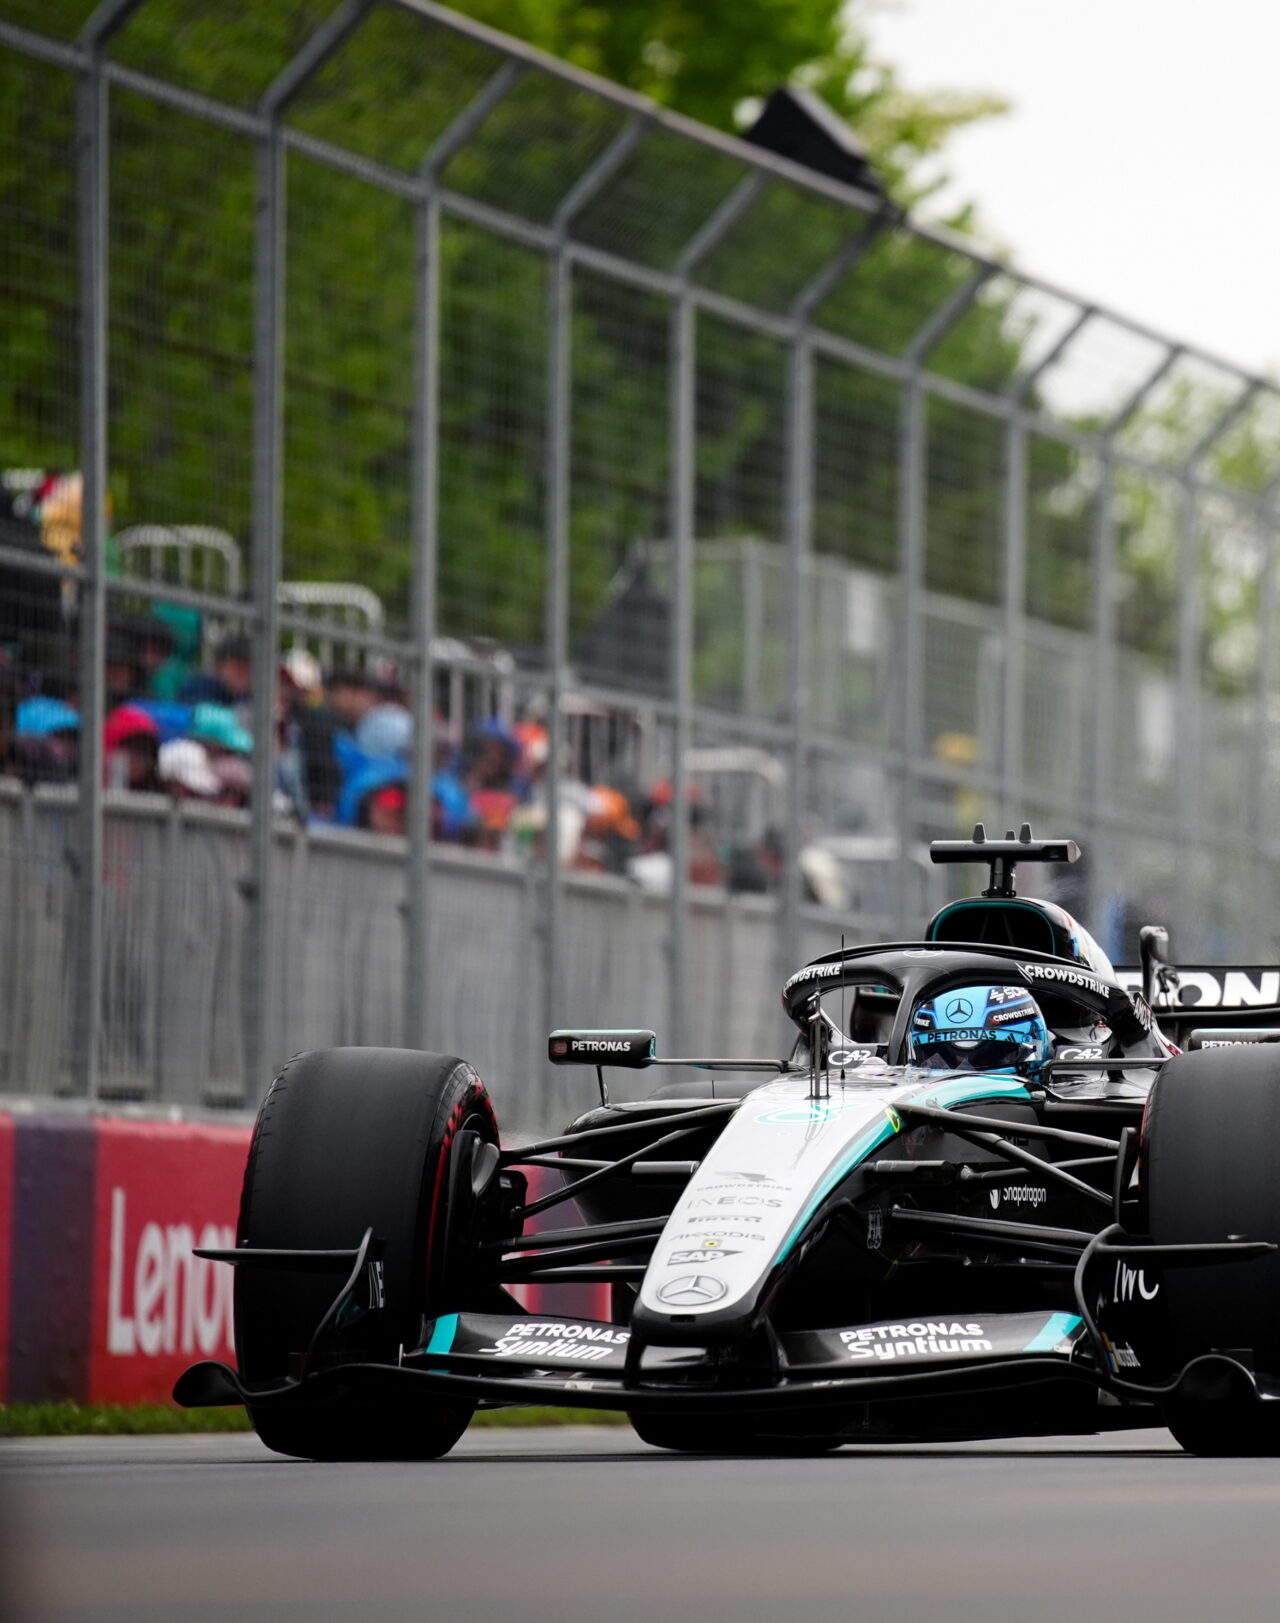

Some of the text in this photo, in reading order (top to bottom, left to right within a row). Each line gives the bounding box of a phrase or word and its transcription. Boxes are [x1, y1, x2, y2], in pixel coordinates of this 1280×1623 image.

[1025, 965, 1110, 999] CROWDSTRIKE
[993, 1008, 1035, 1022] CROWDSTRIKE
[928, 1030, 997, 1042] PETRONAS
[571, 1041, 631, 1052] PETRONAS
[1060, 1048, 1102, 1060] G42
[828, 1050, 871, 1065] G42
[687, 1196, 784, 1209] INEOS
[668, 1250, 729, 1264] SAP
[1113, 1259, 1159, 1303] IWC
[505, 1323, 632, 1345] PETRONAS
[839, 1323, 984, 1344] PETRONAS
[480, 1336, 614, 1360] Syntium
[848, 1335, 993, 1360] Syntium
